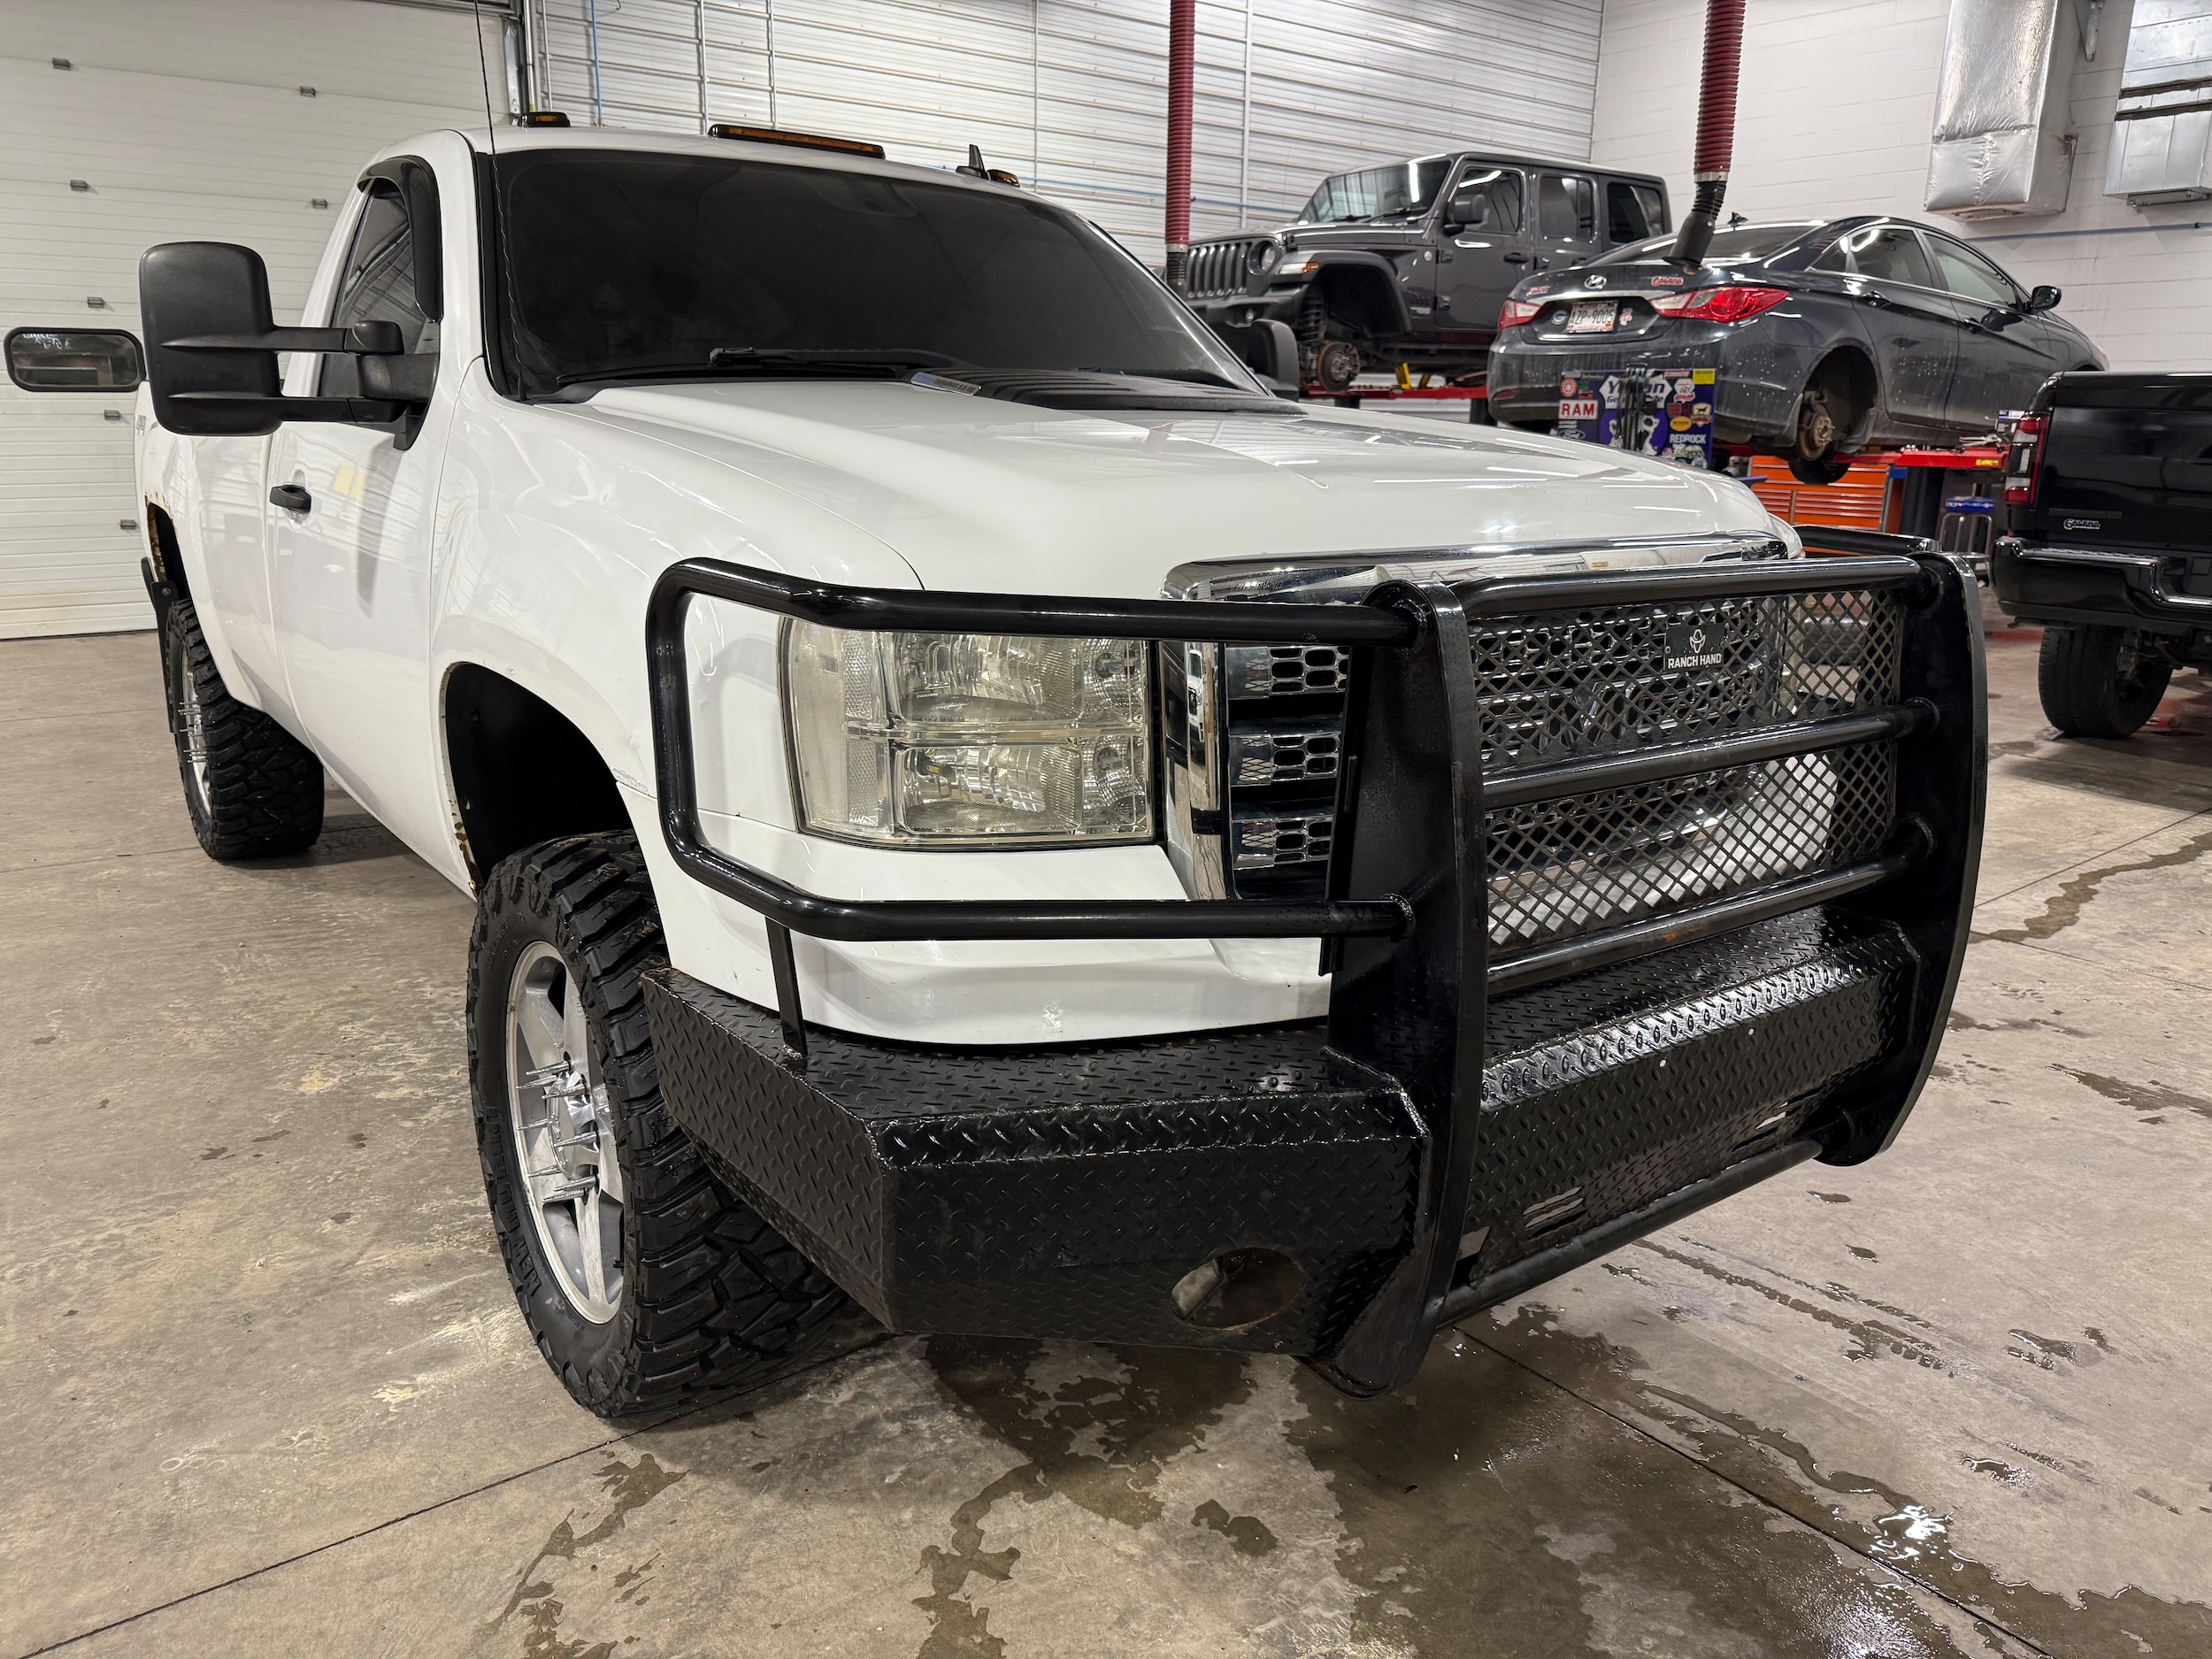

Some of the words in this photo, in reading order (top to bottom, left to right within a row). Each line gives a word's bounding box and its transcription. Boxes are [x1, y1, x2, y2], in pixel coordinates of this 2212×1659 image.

[1562, 403, 1594, 416] RAM
[1670, 434, 1707, 444] REDROCK
[1668, 656, 1699, 669] RANCH
[1700, 653, 1722, 666] HAND
[513, 1236, 541, 1296] NEW
